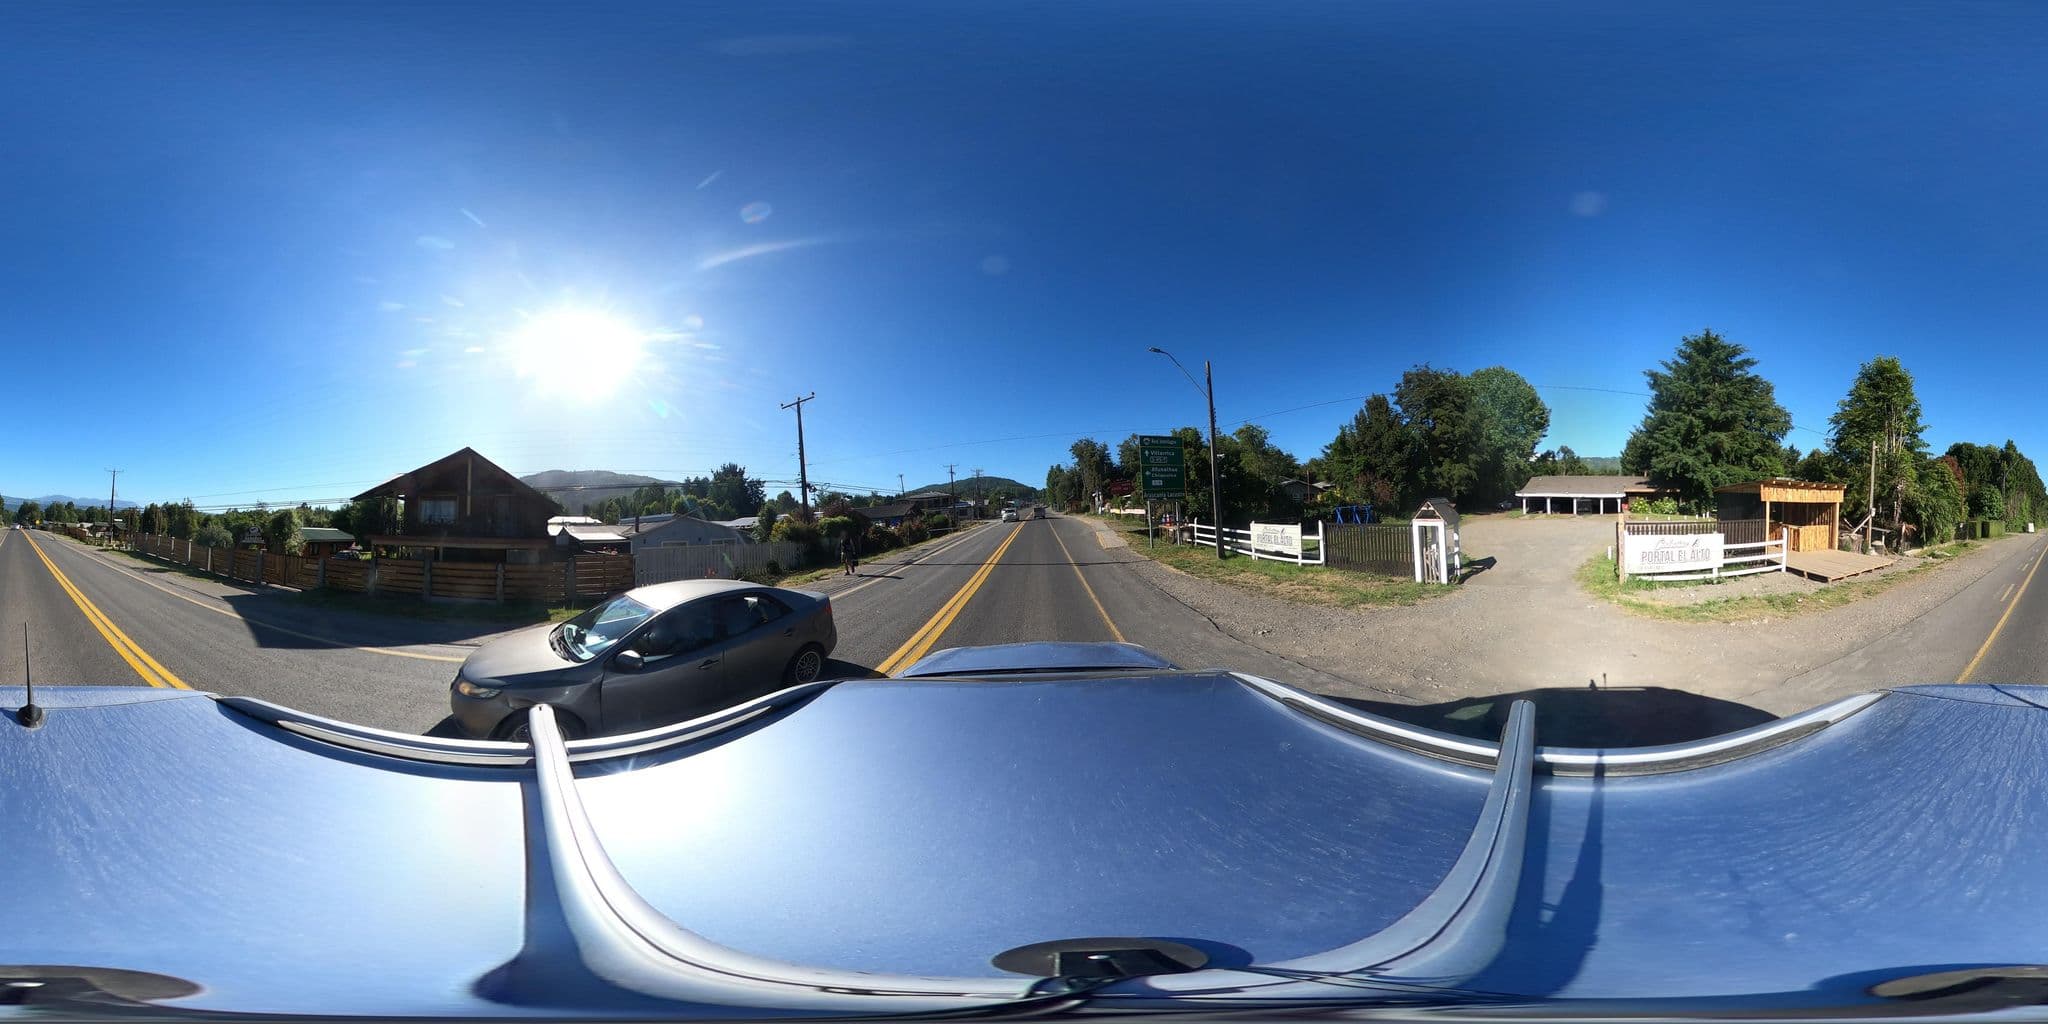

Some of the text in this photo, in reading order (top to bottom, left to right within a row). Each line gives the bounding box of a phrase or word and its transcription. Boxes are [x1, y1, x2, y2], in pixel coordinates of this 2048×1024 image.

[1641, 548, 1711, 563] PORTAL EL ALTO
